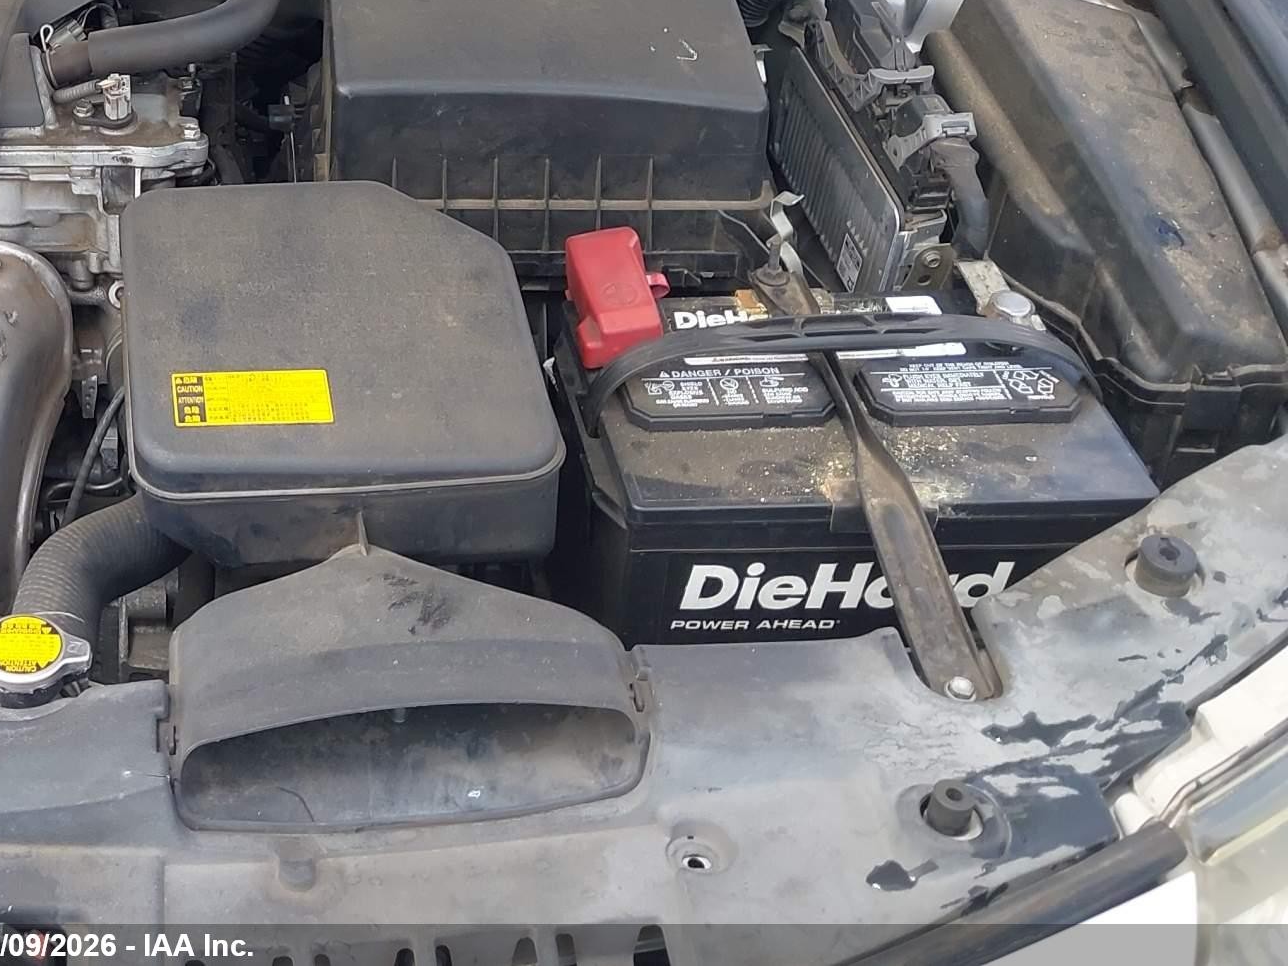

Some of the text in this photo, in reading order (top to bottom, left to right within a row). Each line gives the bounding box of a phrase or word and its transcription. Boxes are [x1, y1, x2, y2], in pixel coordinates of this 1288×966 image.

[671, 369, 722, 378] DANGER
[734, 367, 781, 376] POISON
[177, 385, 204, 394] CAUTION
[670, 619, 751, 631] POWER
[5, 665, 38, 673] CAUTION
